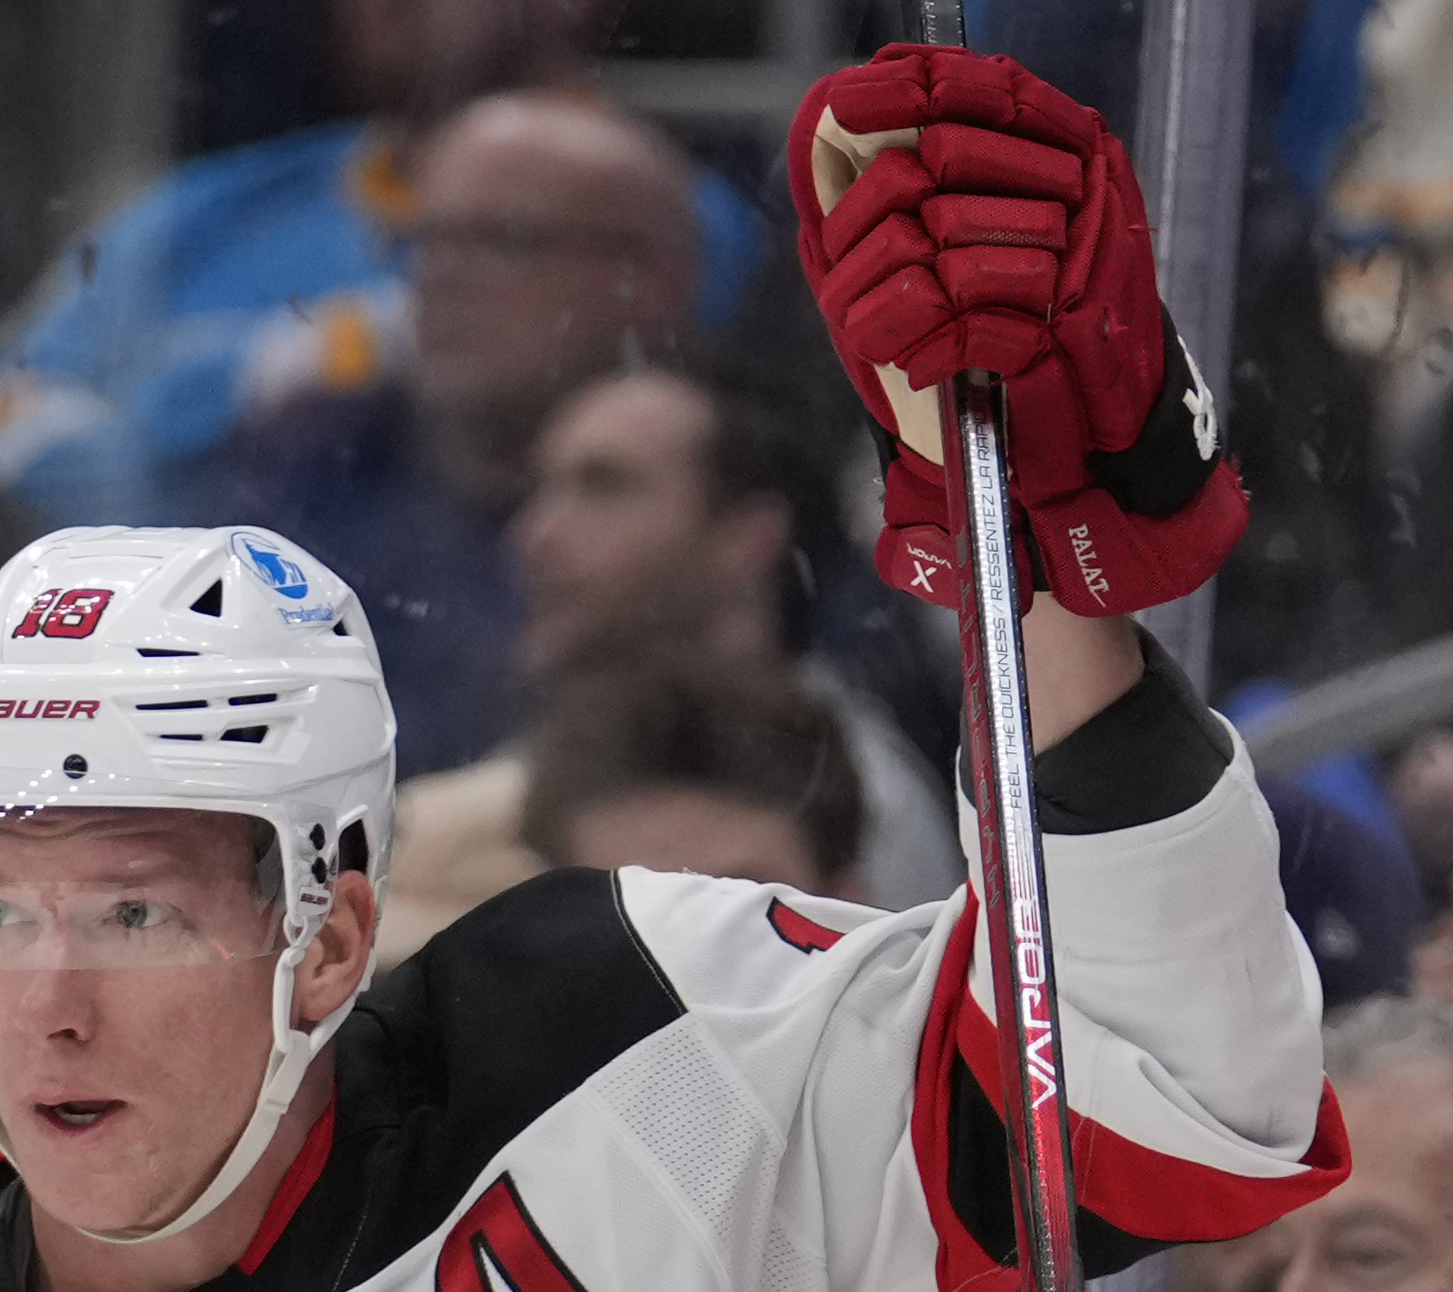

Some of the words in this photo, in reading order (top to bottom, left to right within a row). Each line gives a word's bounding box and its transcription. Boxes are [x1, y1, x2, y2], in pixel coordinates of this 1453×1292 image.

[978, 466, 993, 490] LA
[982, 494, 1004, 602] RESSENTEZ
[1068, 523, 1110, 607] PALAT
[11, 588, 116, 640] 18
[992, 617, 1016, 719] QUICKNESS
[1003, 723, 1016, 757] THE
[1008, 763, 1023, 809] FEEL
